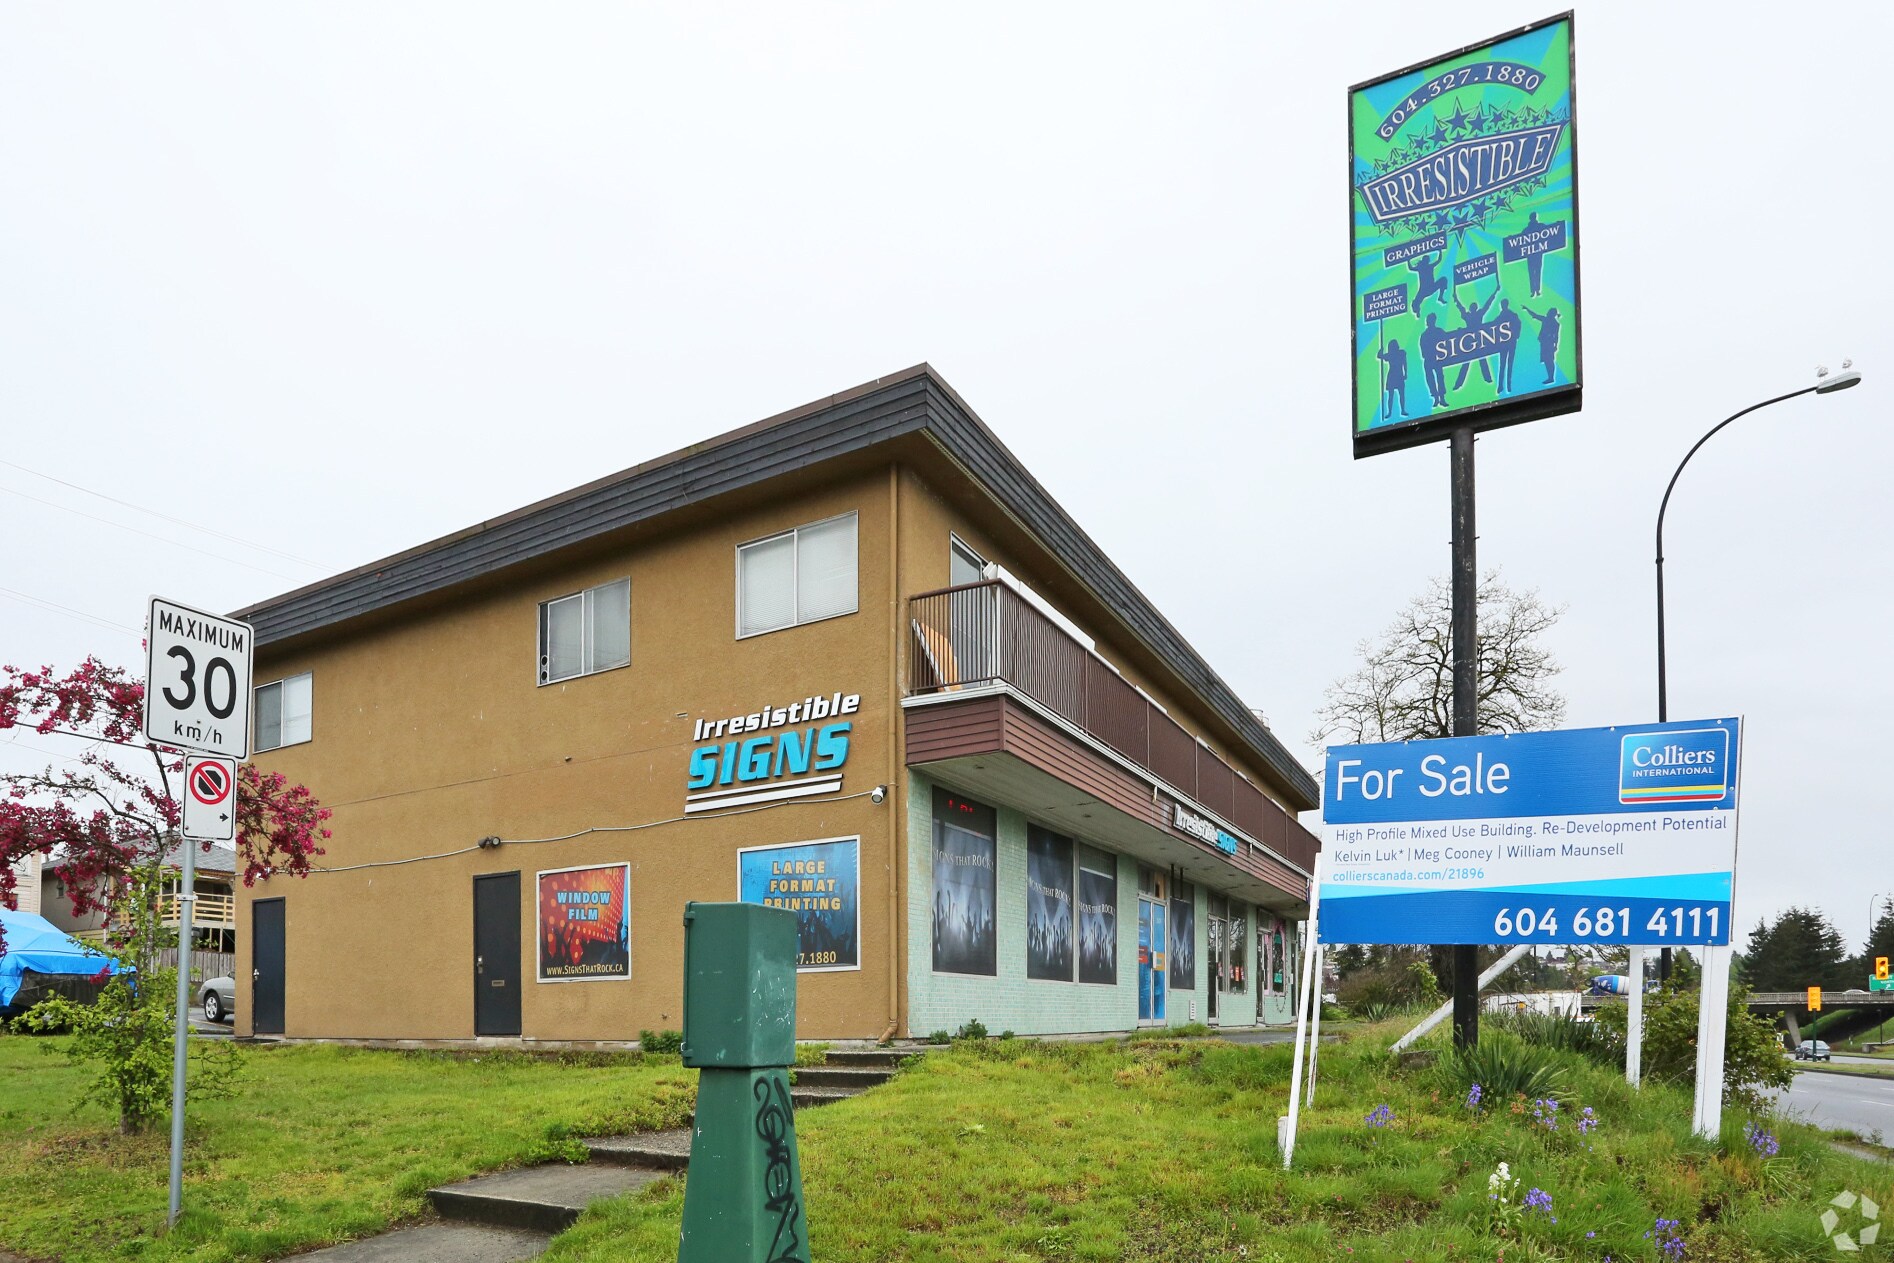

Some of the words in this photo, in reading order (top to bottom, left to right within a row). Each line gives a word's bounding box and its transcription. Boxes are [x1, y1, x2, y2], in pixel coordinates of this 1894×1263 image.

[1380, 64, 1541, 138] 604.327.1880
[1372, 133, 1552, 213] IRRESISTIBLE
[1508, 225, 1560, 248] WINDOW
[1386, 236, 1445, 262] GRAPHICS
[1520, 241, 1548, 257] FILM
[1456, 256, 1495, 274] VEHICLE
[1463, 267, 1489, 280] WRAP
[1369, 296, 1403, 310] FORMAT
[1372, 289, 1399, 302] LARGE
[1366, 303, 1406, 319] PRINTING
[1435, 321, 1512, 361] SIGNS
[159, 609, 244, 653] MAXIMUM
[162, 645, 237, 720] 30
[693, 692, 861, 741] Irresistible
[174, 720, 222, 744] km/h
[687, 721, 852, 790] SIGNS
[1632, 745, 1716, 767] Colliers
[1337, 759, 1404, 801] For
[1418, 752, 1510, 797] Sale
[1632, 766, 1715, 778] INTERNATIONAL
[1336, 828, 1363, 843] High
[1367, 827, 1406, 840] Profile
[1411, 825, 1447, 839] Mixed
[1452, 825, 1476, 838] Use
[1480, 822, 1537, 838] Building.
[1542, 818, 1657, 836] Re-Development
[1662, 815, 1727, 831] Potential
[1335, 850, 1371, 862] Kelvin
[1414, 848, 1440, 863] Meg
[1444, 846, 1493, 861] Cooney
[1506, 843, 1556, 858] William
[1561, 842, 1624, 857] Maunsell
[773, 860, 826, 875] LARGE
[1333, 867, 1485, 882] collierscanada.com/21896
[770, 878, 836, 893] FORMAT
[557, 891, 611, 904] WINDOW
[764, 897, 841, 910] PRINTING
[568, 908, 599, 920] FILM
[1494, 907, 1558, 937] 604
[1573, 907, 1631, 937] 681
[1646, 907, 1719, 937] 4111
